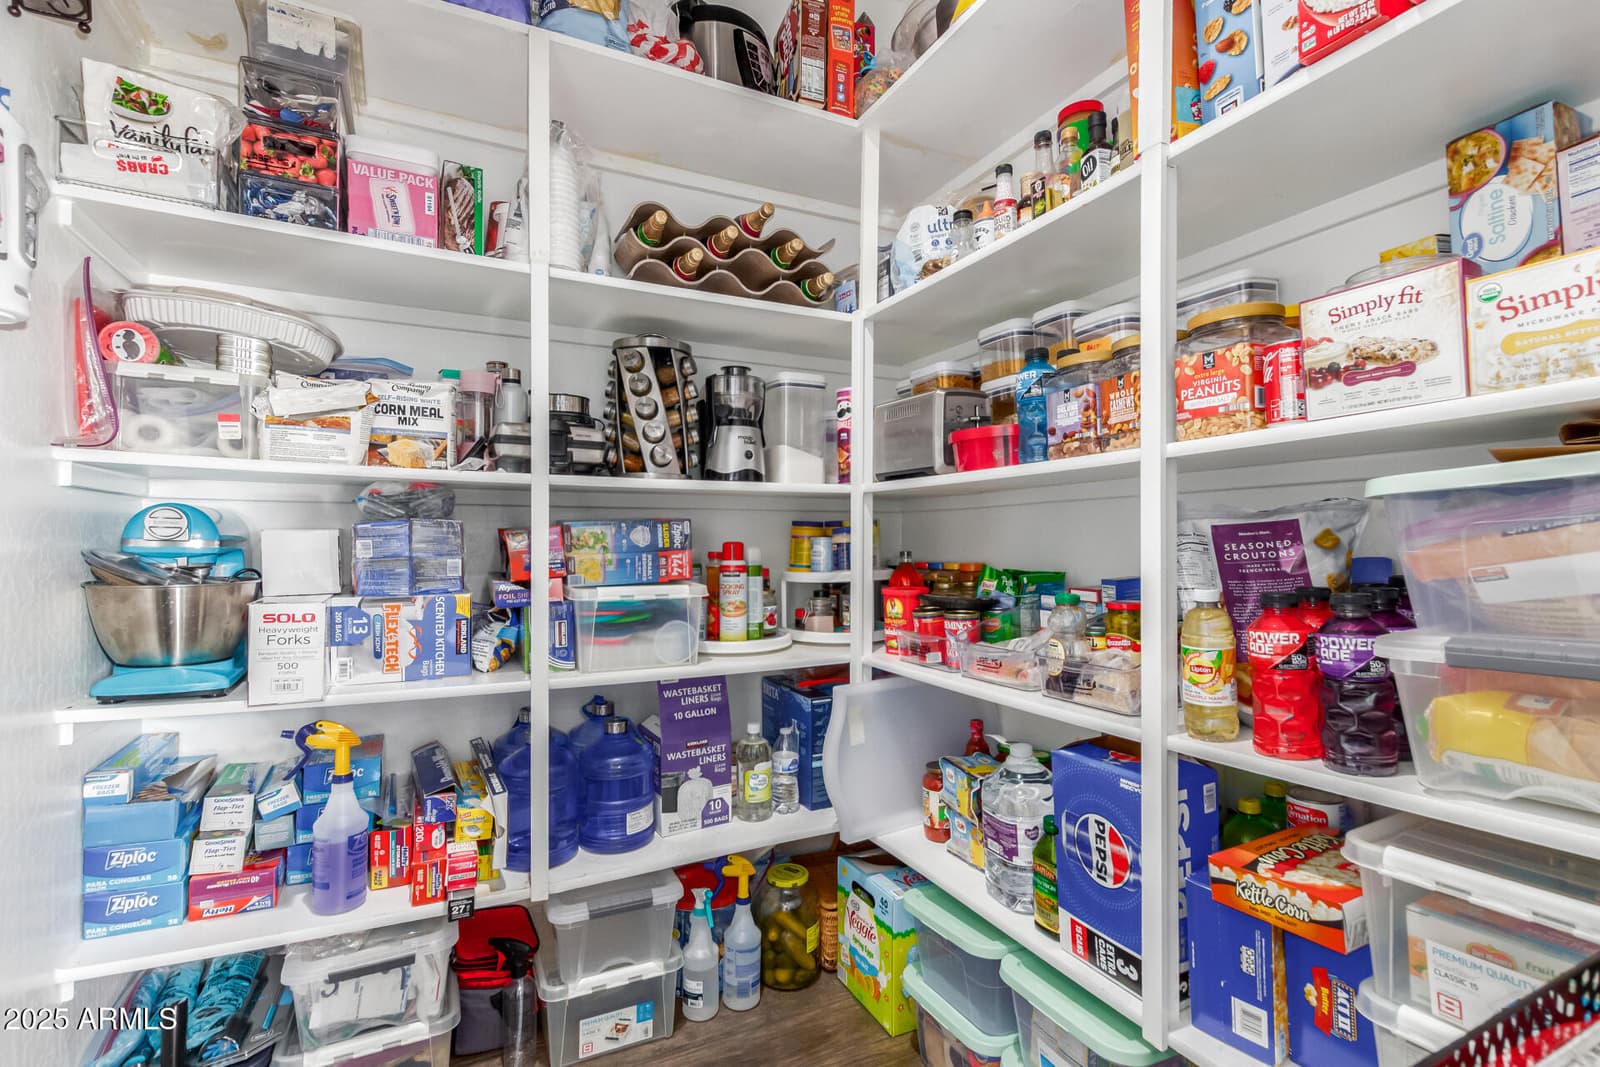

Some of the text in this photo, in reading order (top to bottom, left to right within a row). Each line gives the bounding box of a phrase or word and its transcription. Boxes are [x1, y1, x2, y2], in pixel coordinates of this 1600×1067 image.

[116, 159, 169, 175] CRABS
[352, 162, 434, 189] VALUE PACK
[1488, 188, 1506, 246] Saltine
[1507, 195, 1517, 226] Crackers
[1328, 285, 1424, 325] Simply fit
[1517, 309, 1585, 328] MICROWAVE
[1193, 367, 1225, 379] extra large
[1180, 379, 1241, 400] PEANUTS
[1192, 376, 1228, 388] VIRGINIA
[1109, 387, 1134, 399] WHOLE
[374, 403, 444, 419] CORN MEAL
[397, 415, 419, 427] MIX
[661, 522, 670, 548] SLIDER
[671, 523, 683, 550] Ziploc
[1223, 539, 1292, 551] SEASONED
[1223, 548, 1296, 561] CROUTONS
[671, 552, 683, 578] 144
[498, 592, 516, 601] FOIL
[722, 588, 741, 596] SPRAY
[262, 612, 316, 624] SOLO
[352, 617, 368, 635] 13
[258, 626, 319, 634] Heavyweight
[435, 595, 445, 676] SCENTED KITCHEN
[1248, 631, 1301, 645] POWER
[266, 634, 311, 646] Forks
[383, 603, 401, 674] FLEX-TECH
[1248, 643, 1275, 655] ADE
[1320, 648, 1350, 662] ADE
[277, 662, 299, 670] 500
[422, 660, 430, 677] Bags
[1190, 664, 1213, 673] Lipton
[662, 683, 722, 699] WASTEBASKET
[681, 695, 709, 706] LINERS
[673, 707, 717, 721] 10 GALLON
[666, 743, 727, 762] WASTEBASKET
[699, 752, 727, 766] LINERS
[213, 803, 245, 812] Flap-Ties
[710, 799, 722, 811] 10
[713, 814, 729, 823] BAGS
[415, 826, 425, 843] 200
[204, 846, 237, 855] Flap-Ties
[1093, 818, 1108, 884] PEPSI
[1297, 832, 1342, 855] Kettle
[108, 848, 158, 867] Ziploc
[401, 847, 409, 868] Hefty
[85, 880, 107, 889] PARA
[109, 874, 151, 886] CONGELAR
[108, 894, 158, 914] Ziploc
[1235, 879, 1275, 909] Kettle
[1274, 892, 1312, 923] Corn
[202, 905, 234, 917] Hefty
[451, 904, 466, 915] 27
[85, 926, 107, 936] PARA
[846, 906, 877, 945] Veggie
[1074, 935, 1084, 957] CANS
[1097, 938, 1107, 971] CANS
[1104, 944, 1117, 978] EXTRA
[1118, 961, 1140, 982] 3
[1431, 946, 1484, 974] PREMIUM
[1485, 966, 1537, 992] QUALITY
[1433, 967, 1467, 987] CLASSIC
[1525, 961, 1555, 977] Fruit
[1320, 986, 1330, 1016] Butter
[1336, 986, 1351, 1016] ACT
